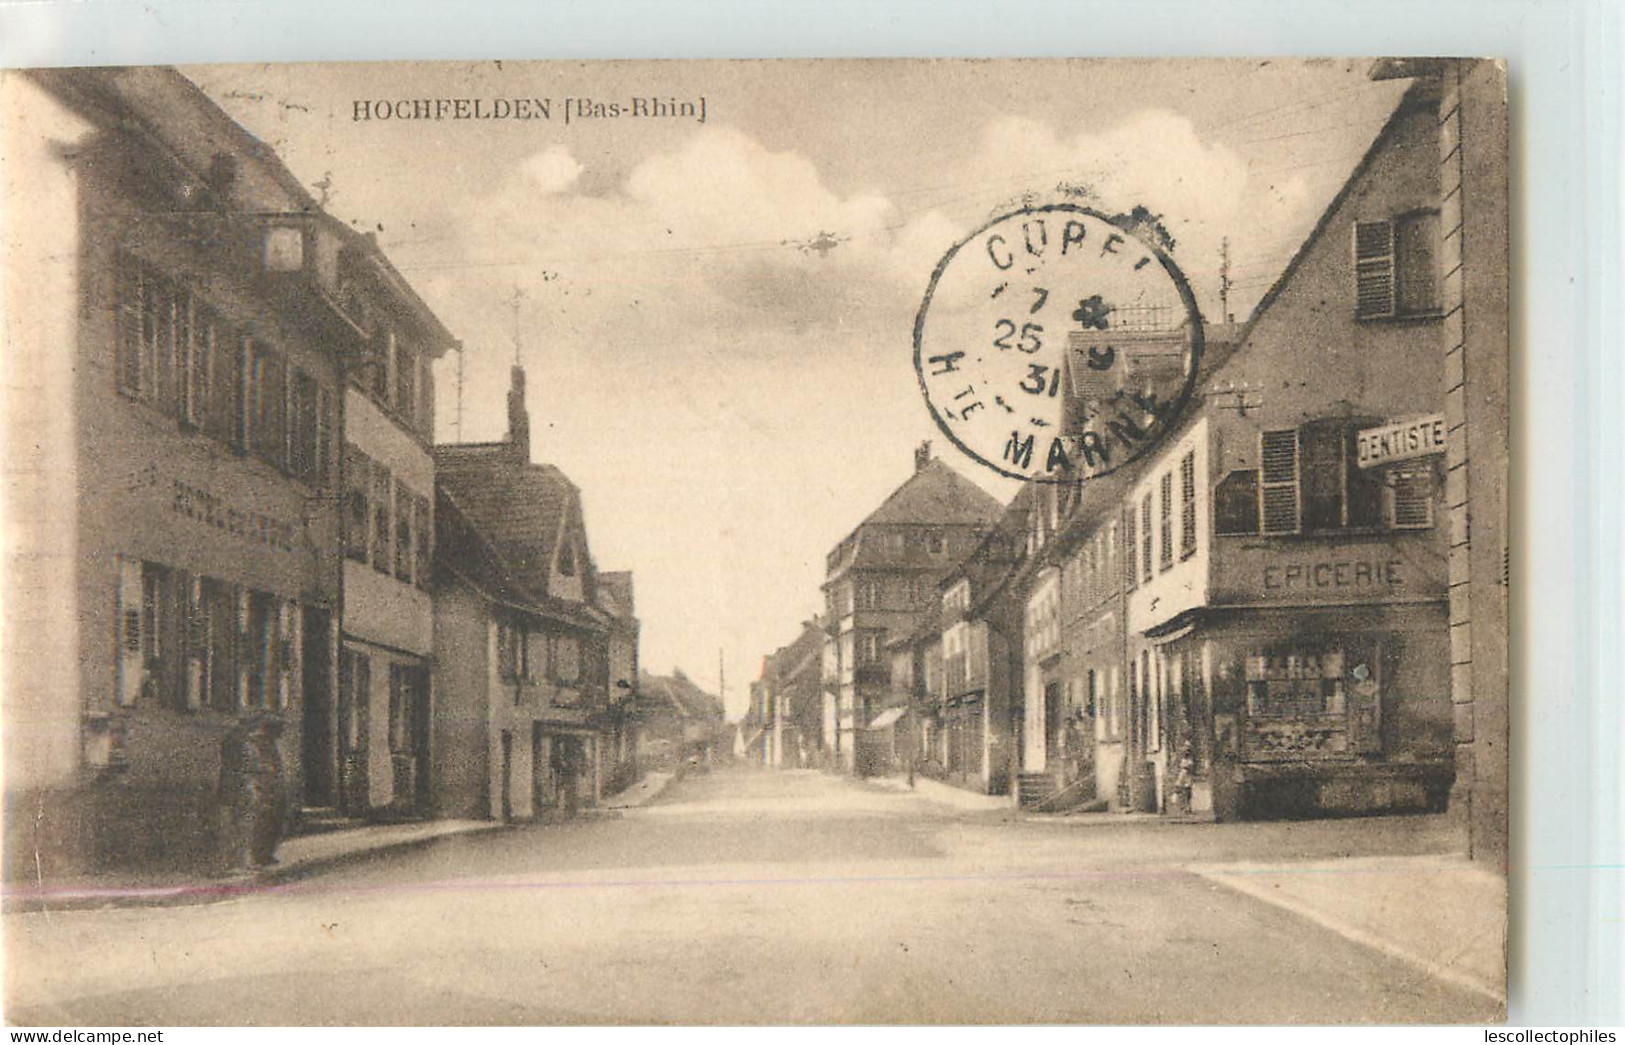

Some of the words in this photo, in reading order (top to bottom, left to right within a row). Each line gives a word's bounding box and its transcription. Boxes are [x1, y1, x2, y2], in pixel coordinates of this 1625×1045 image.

[994, 319, 1044, 354] 25
[1019, 363, 1060, 398] 31
[1359, 420, 1444, 462] DENTISTE
[1264, 560, 1402, 589] EPICERIE
